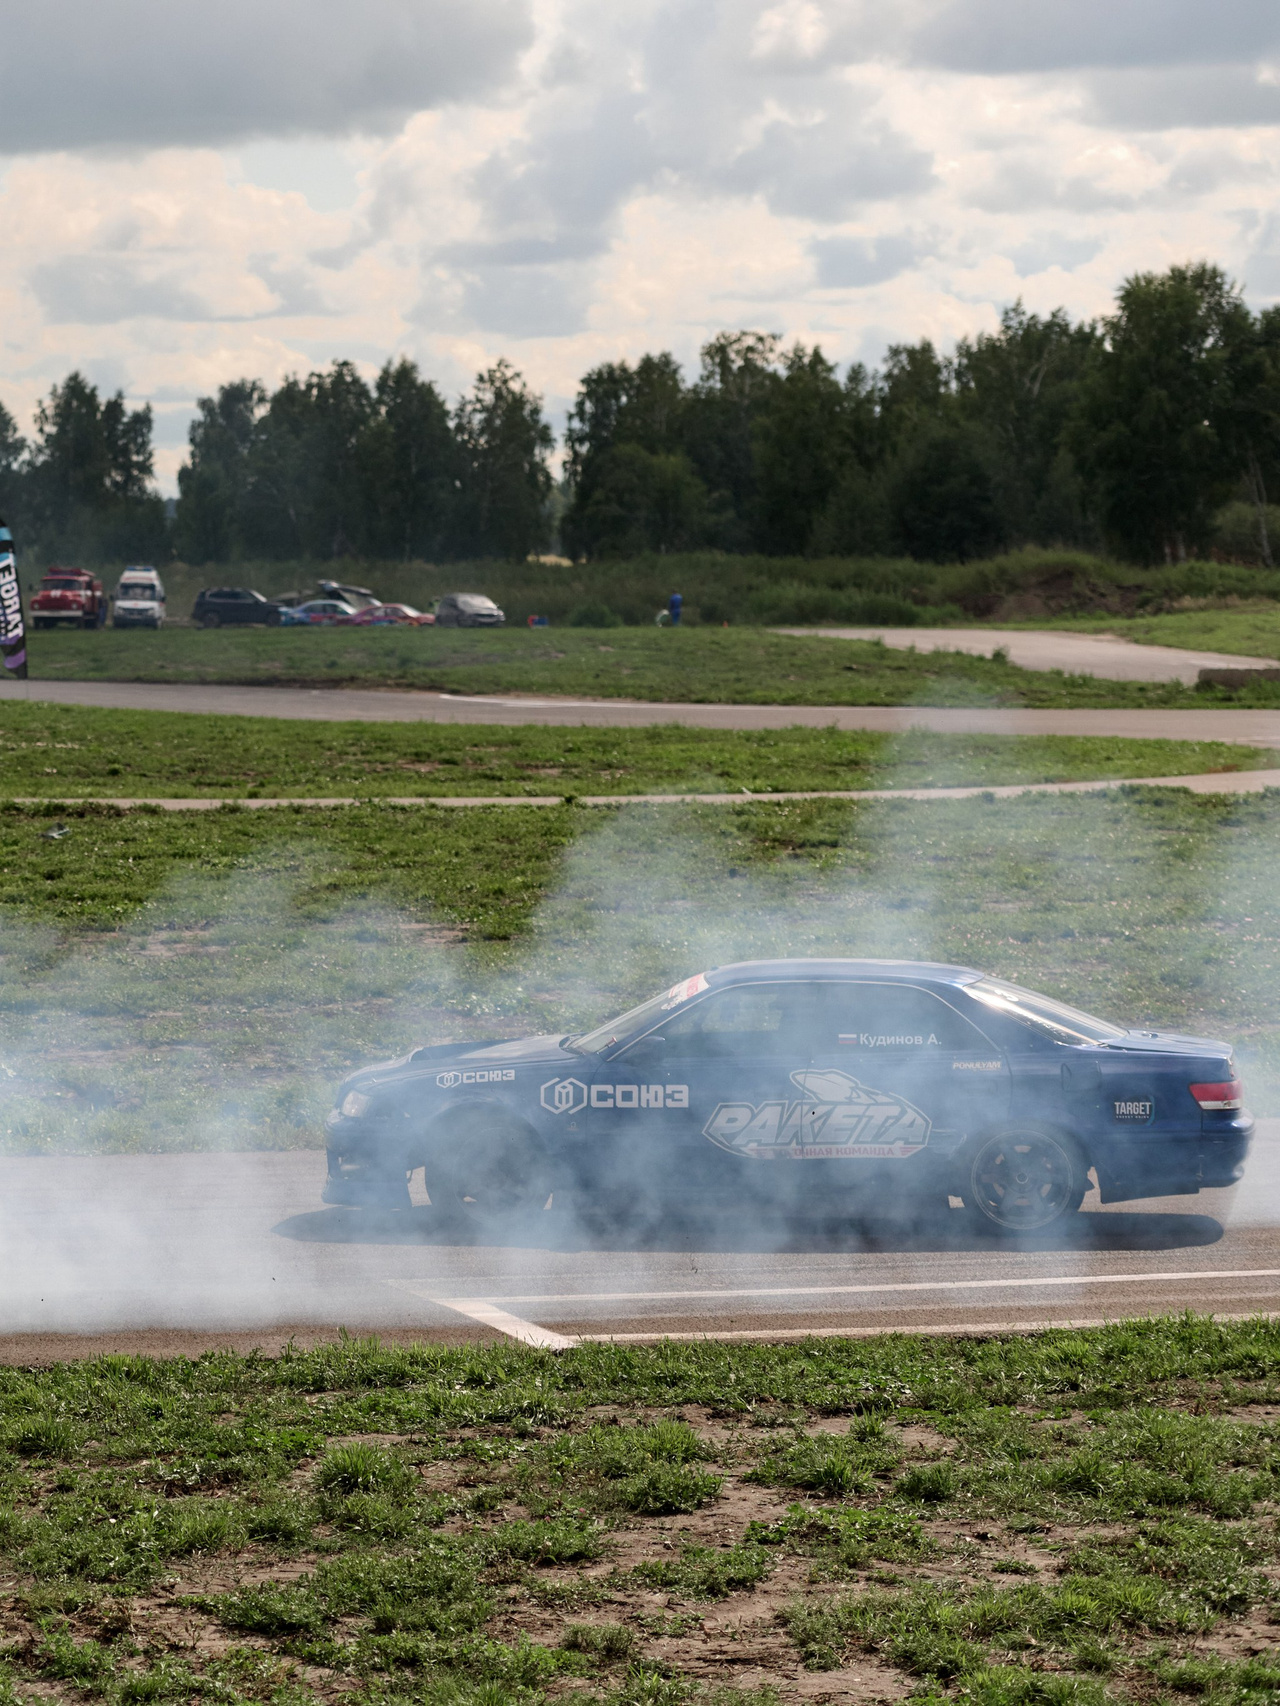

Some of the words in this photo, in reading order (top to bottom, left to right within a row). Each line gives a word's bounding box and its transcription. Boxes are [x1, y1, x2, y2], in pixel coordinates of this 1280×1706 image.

[859, 1033, 923, 1048] Кудинов
[462, 1069, 515, 1084] СОЮЗ
[590, 1084, 689, 1108] СОЮЗ
[1114, 1101, 1152, 1115] TARGET
[706, 1103, 926, 1147] РАКЕТА
[835, 1146, 895, 1157] КОМАНДА
